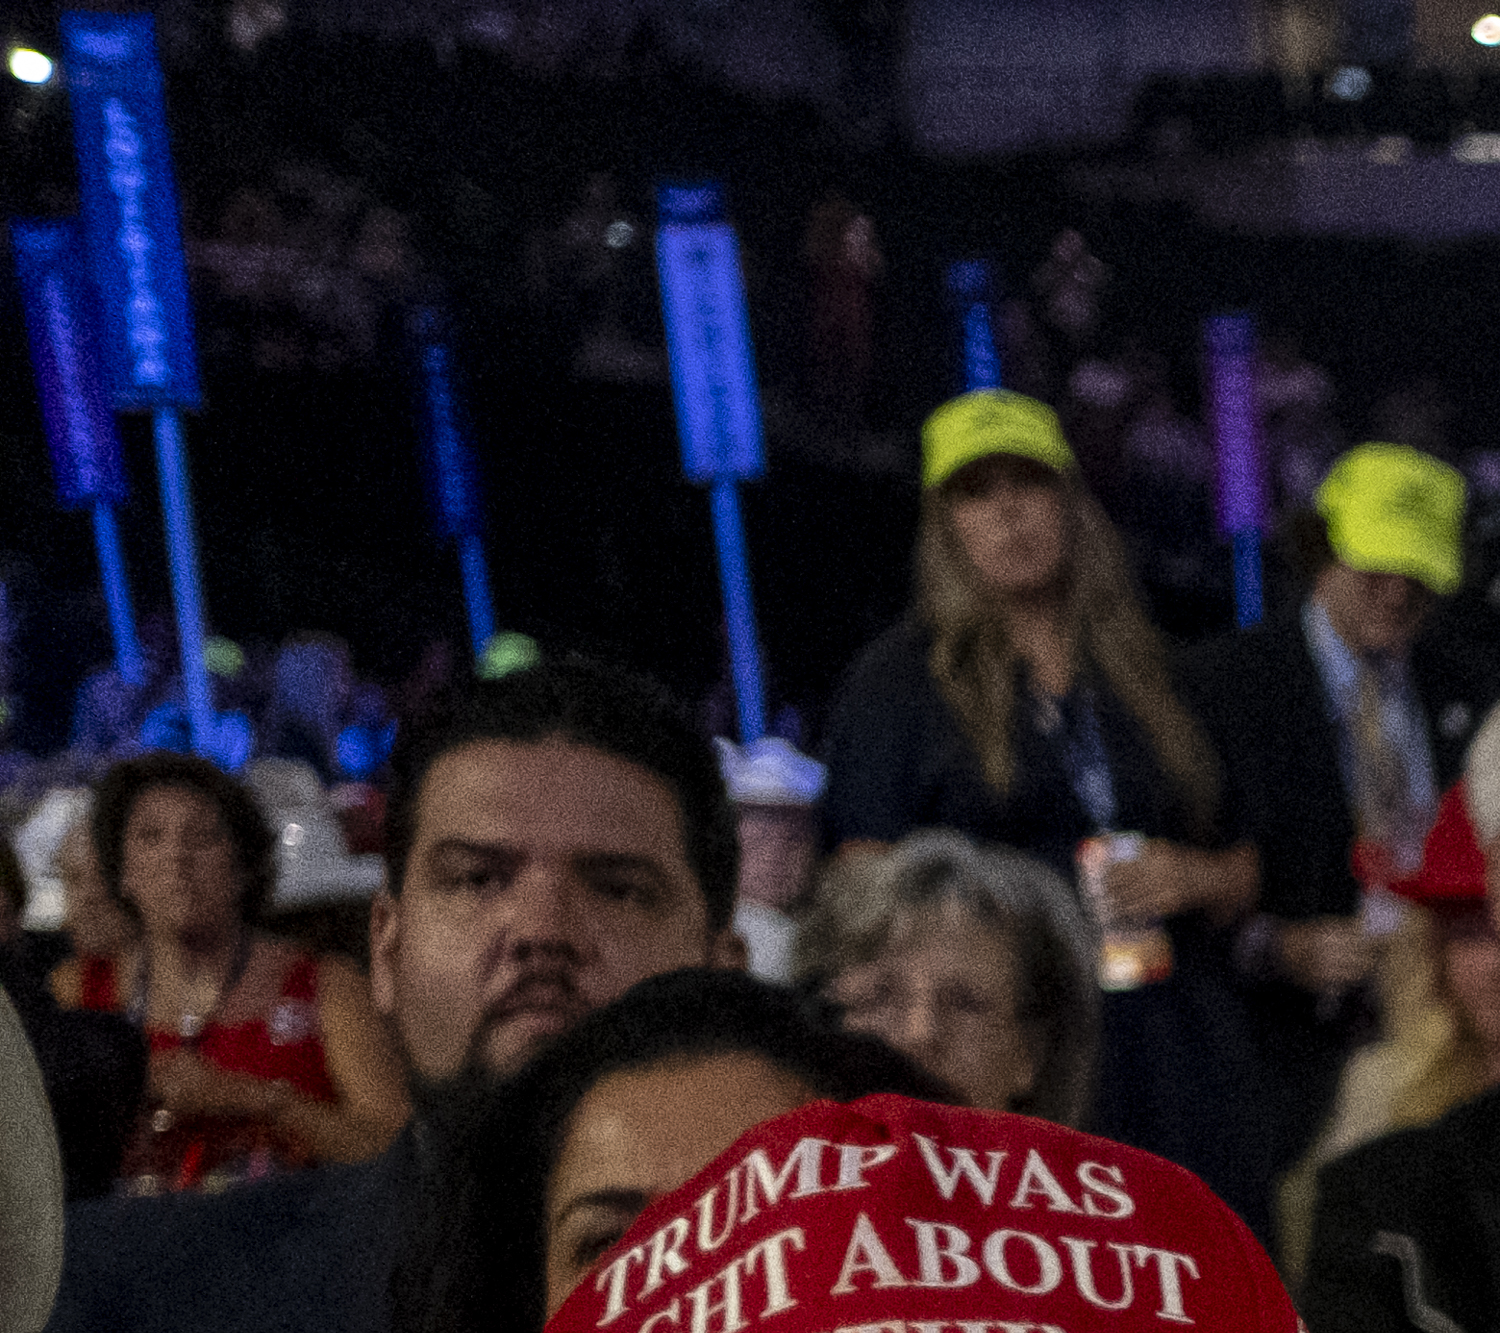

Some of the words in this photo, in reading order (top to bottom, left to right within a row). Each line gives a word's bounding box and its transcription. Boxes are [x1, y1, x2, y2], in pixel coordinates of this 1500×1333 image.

[596, 1136, 900, 1326] TRUMP
[912, 1132, 1138, 1220] WAS
[831, 1212, 1200, 1325] ABOUT
